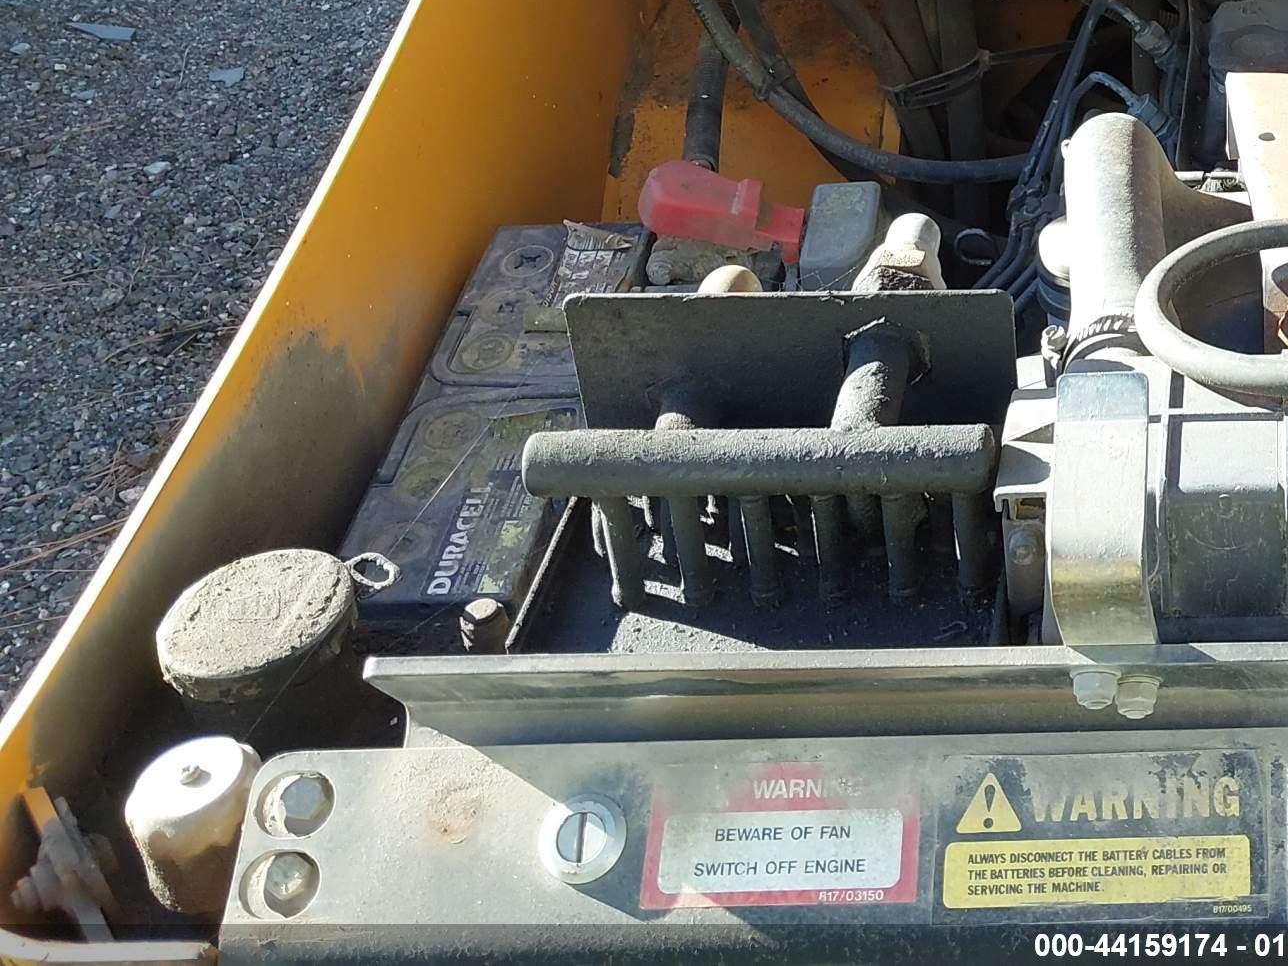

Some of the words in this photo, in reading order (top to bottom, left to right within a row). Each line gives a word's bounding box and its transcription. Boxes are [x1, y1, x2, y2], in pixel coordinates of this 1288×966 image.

[1030, 775, 1241, 823] WARNING
[714, 826, 783, 842] BEWARE
[790, 825, 813, 840] OF
[819, 825, 851, 840] FAN
[967, 852, 1007, 865] ALWAYS
[1009, 851, 1073, 864] DISCONNECT
[1078, 850, 1099, 862] THE
[1102, 849, 1149, 862] BATTERY
[1152, 848, 1192, 860] CABLES
[1196, 847, 1226, 859] FROM
[693, 861, 758, 877] SWITCH
[765, 861, 797, 876] OFF
[804, 859, 866, 875] ENGINE
[968, 868, 988, 880] THE
[990, 867, 1046, 880] BATTERIES
[1048, 866, 1089, 879] BEFORE
[1091, 864, 1147, 878] CLEANING,
[1151, 863, 1208, 876] REPAIRING
[1211, 863, 1227, 875] OR
[967, 884, 1023, 897] SERVICING
[1027, 882, 1048, 895] THE
[1051, 880, 1105, 894] MACHINE.
